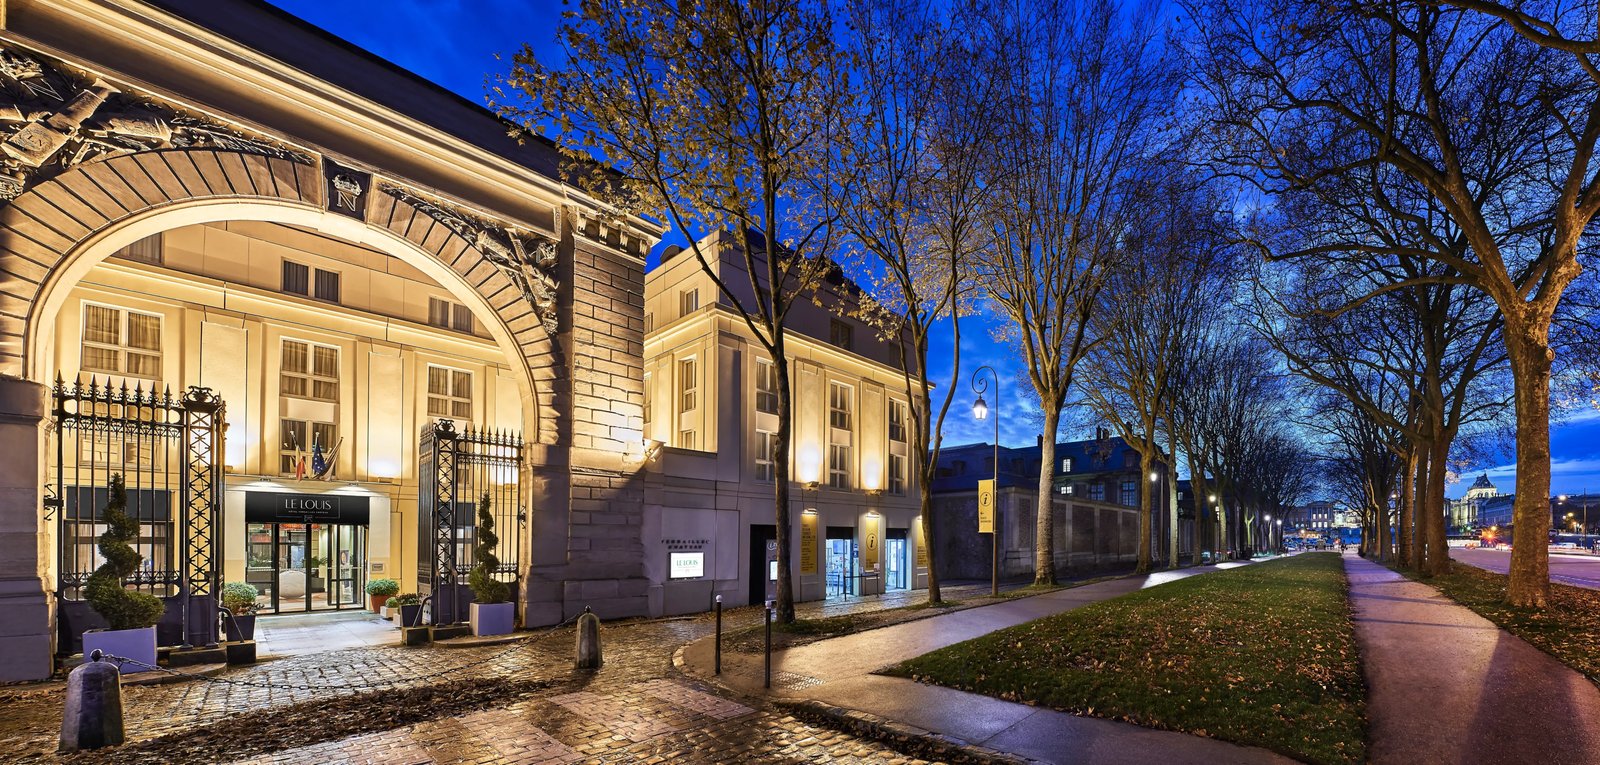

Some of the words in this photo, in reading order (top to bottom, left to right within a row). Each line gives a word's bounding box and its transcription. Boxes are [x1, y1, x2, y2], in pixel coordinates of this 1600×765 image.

[336, 190, 358, 212] N
[285, 498, 297, 509] LE
[300, 499, 332, 510] LOUIS
